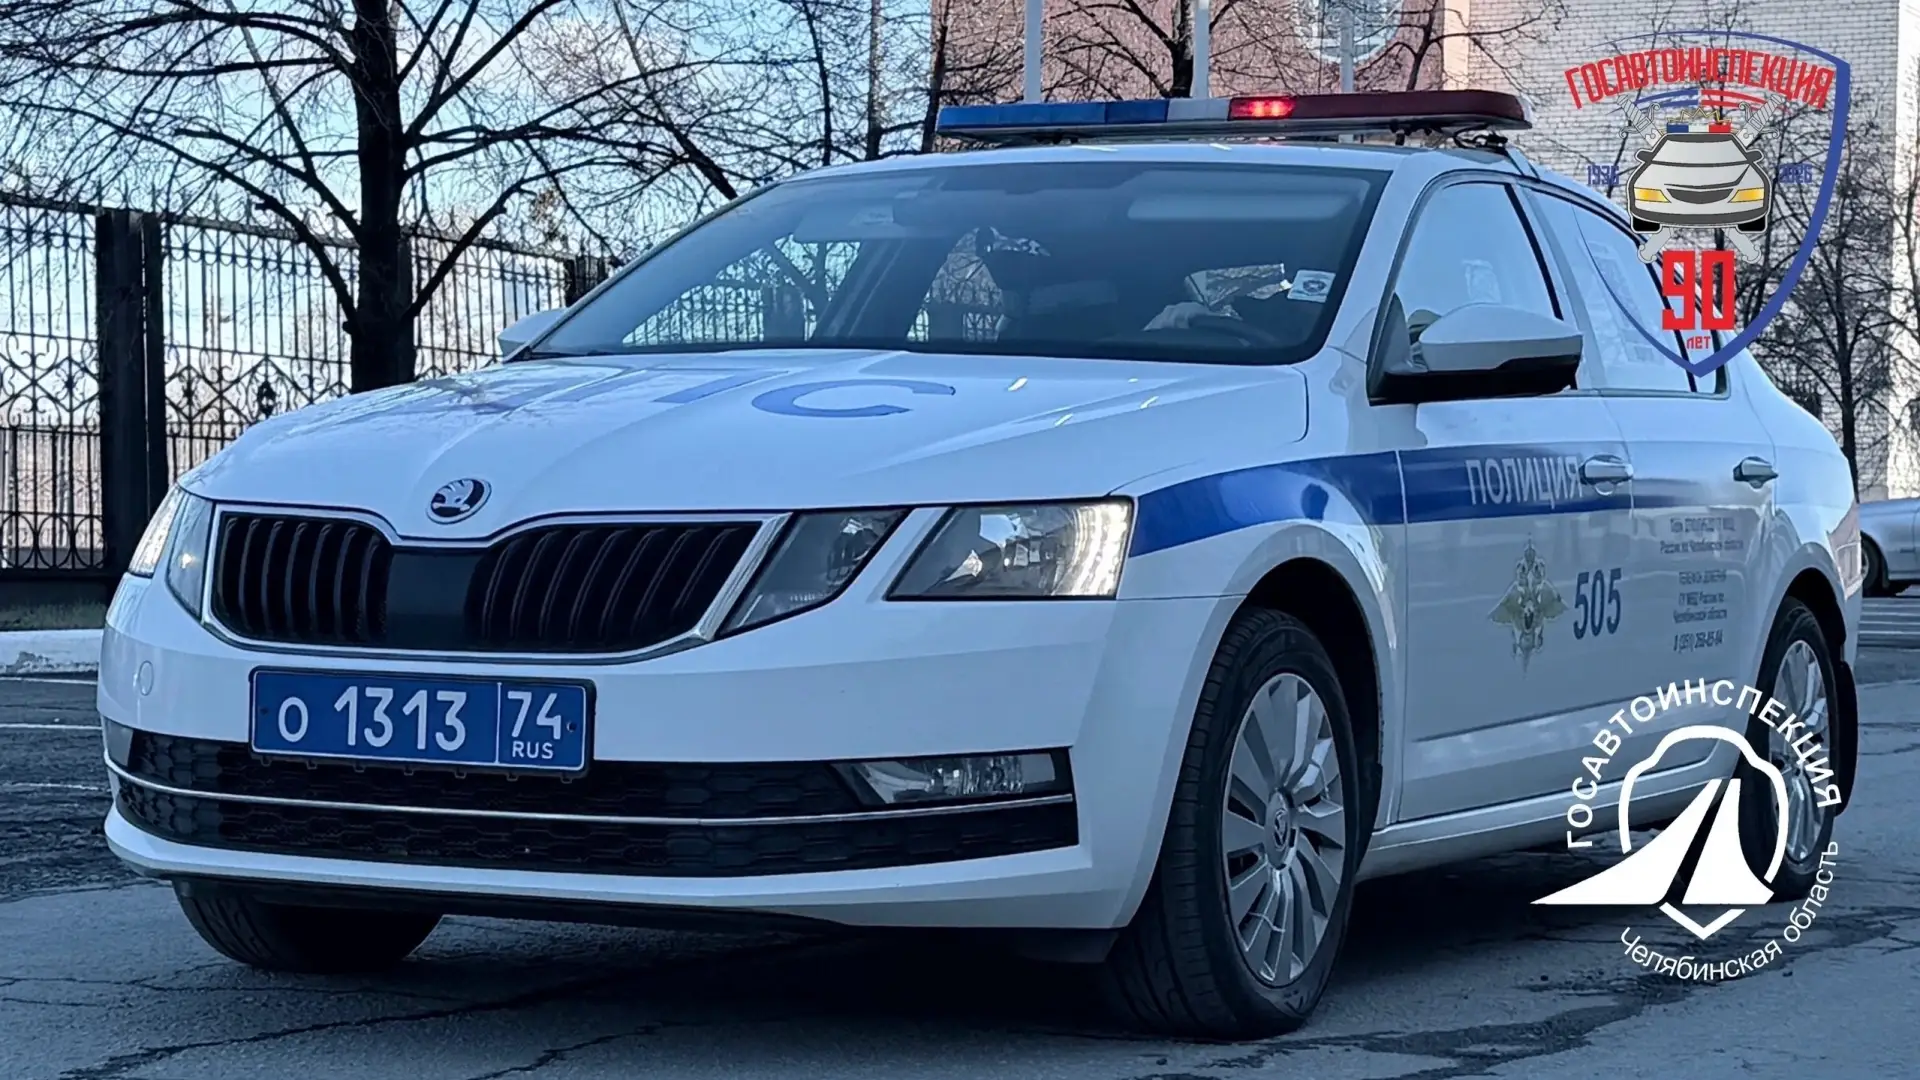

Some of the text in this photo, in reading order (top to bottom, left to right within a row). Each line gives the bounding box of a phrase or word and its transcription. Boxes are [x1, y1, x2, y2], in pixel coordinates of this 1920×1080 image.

[1465, 455, 1583, 510] ПОЛИЦИЯ
[1573, 567, 1622, 640] 505
[334, 686, 467, 752] 1313
[507, 690, 562, 740] 74
[512, 741, 554, 760] RUS
